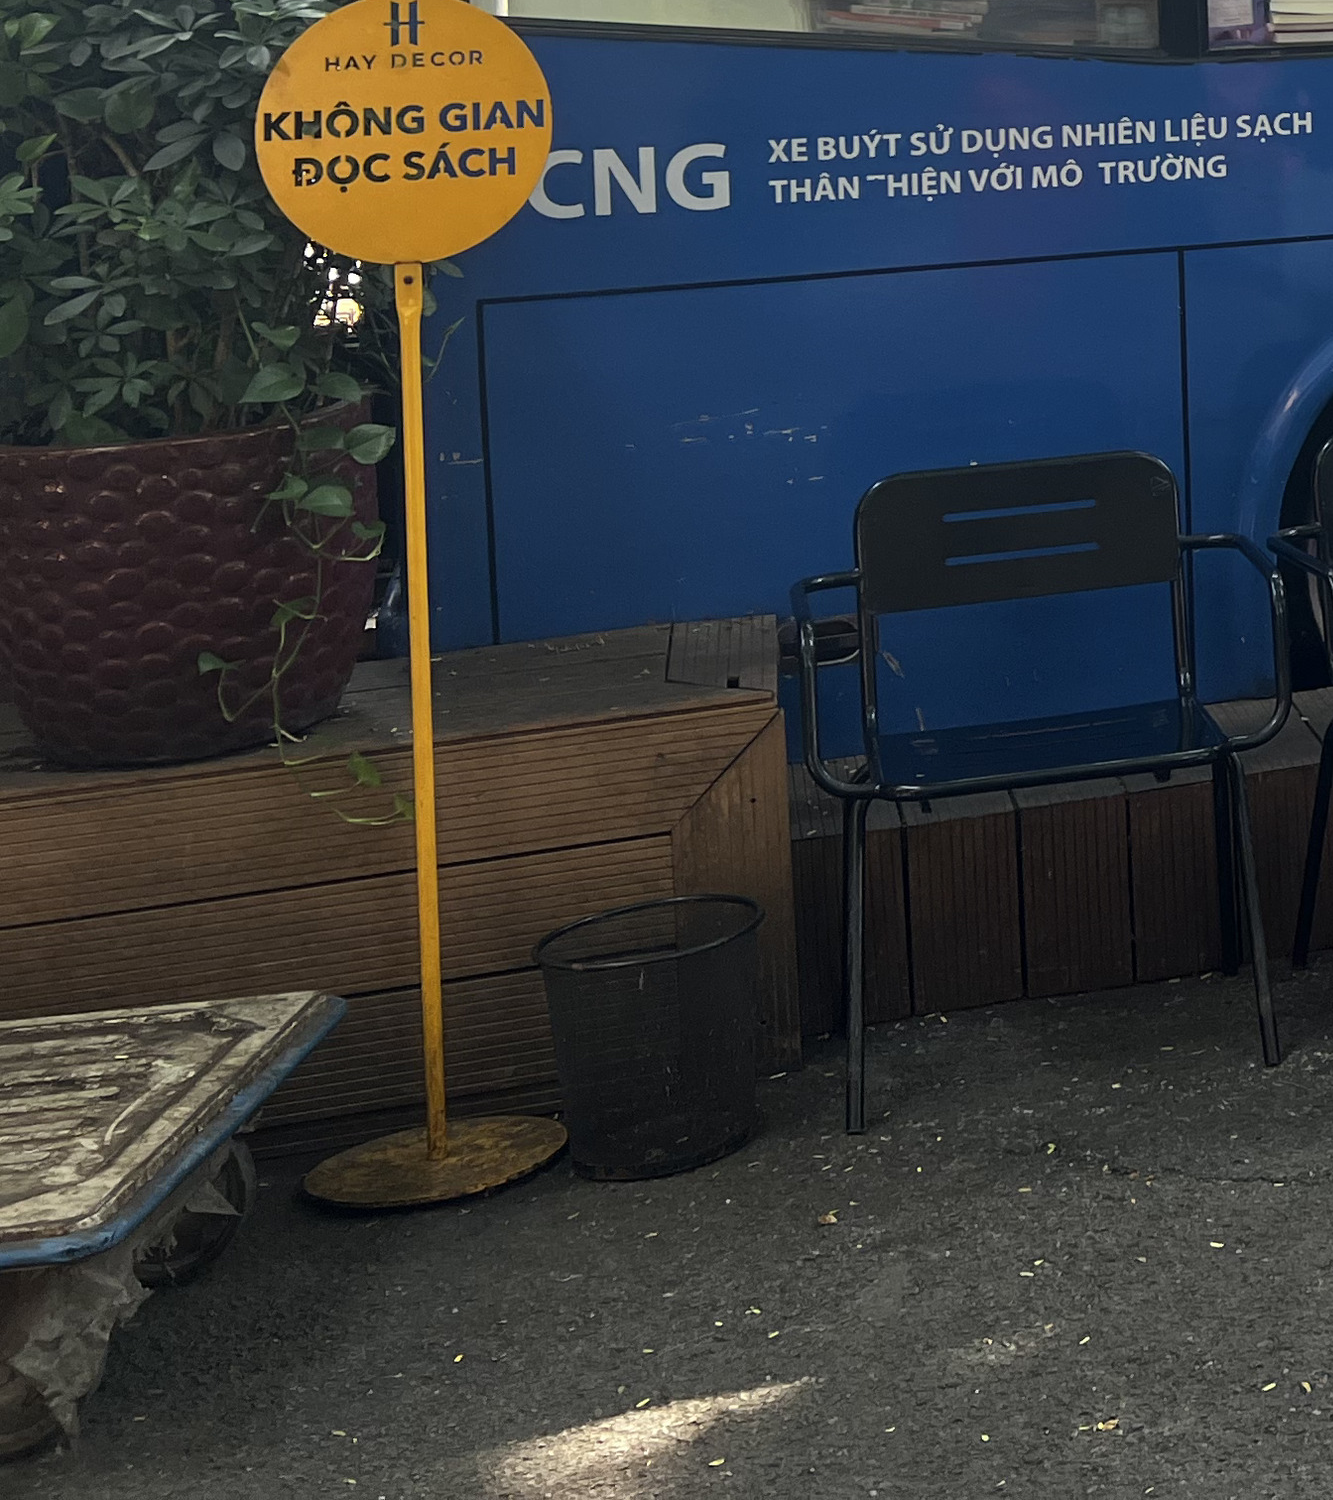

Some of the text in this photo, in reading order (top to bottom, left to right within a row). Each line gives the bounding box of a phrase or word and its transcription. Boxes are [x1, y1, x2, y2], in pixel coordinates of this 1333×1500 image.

[325, 50, 483, 72] HAY DECOR
[262, 98, 545, 141] KHÔNG GIAN
[767, 111, 1314, 164] XE BUÝT SỬ DỤNG NHIÊN LIỆU SẠCH
[292, 142, 516, 193] ĐỌC SÁCH
[528, 141, 731, 220] CNG
[768, 171, 860, 204] THÂN
[866, 166, 962, 202] HIỆN
[969, 160, 1024, 193] VỚI
[1098, 152, 1229, 186] TRƯỜNG
